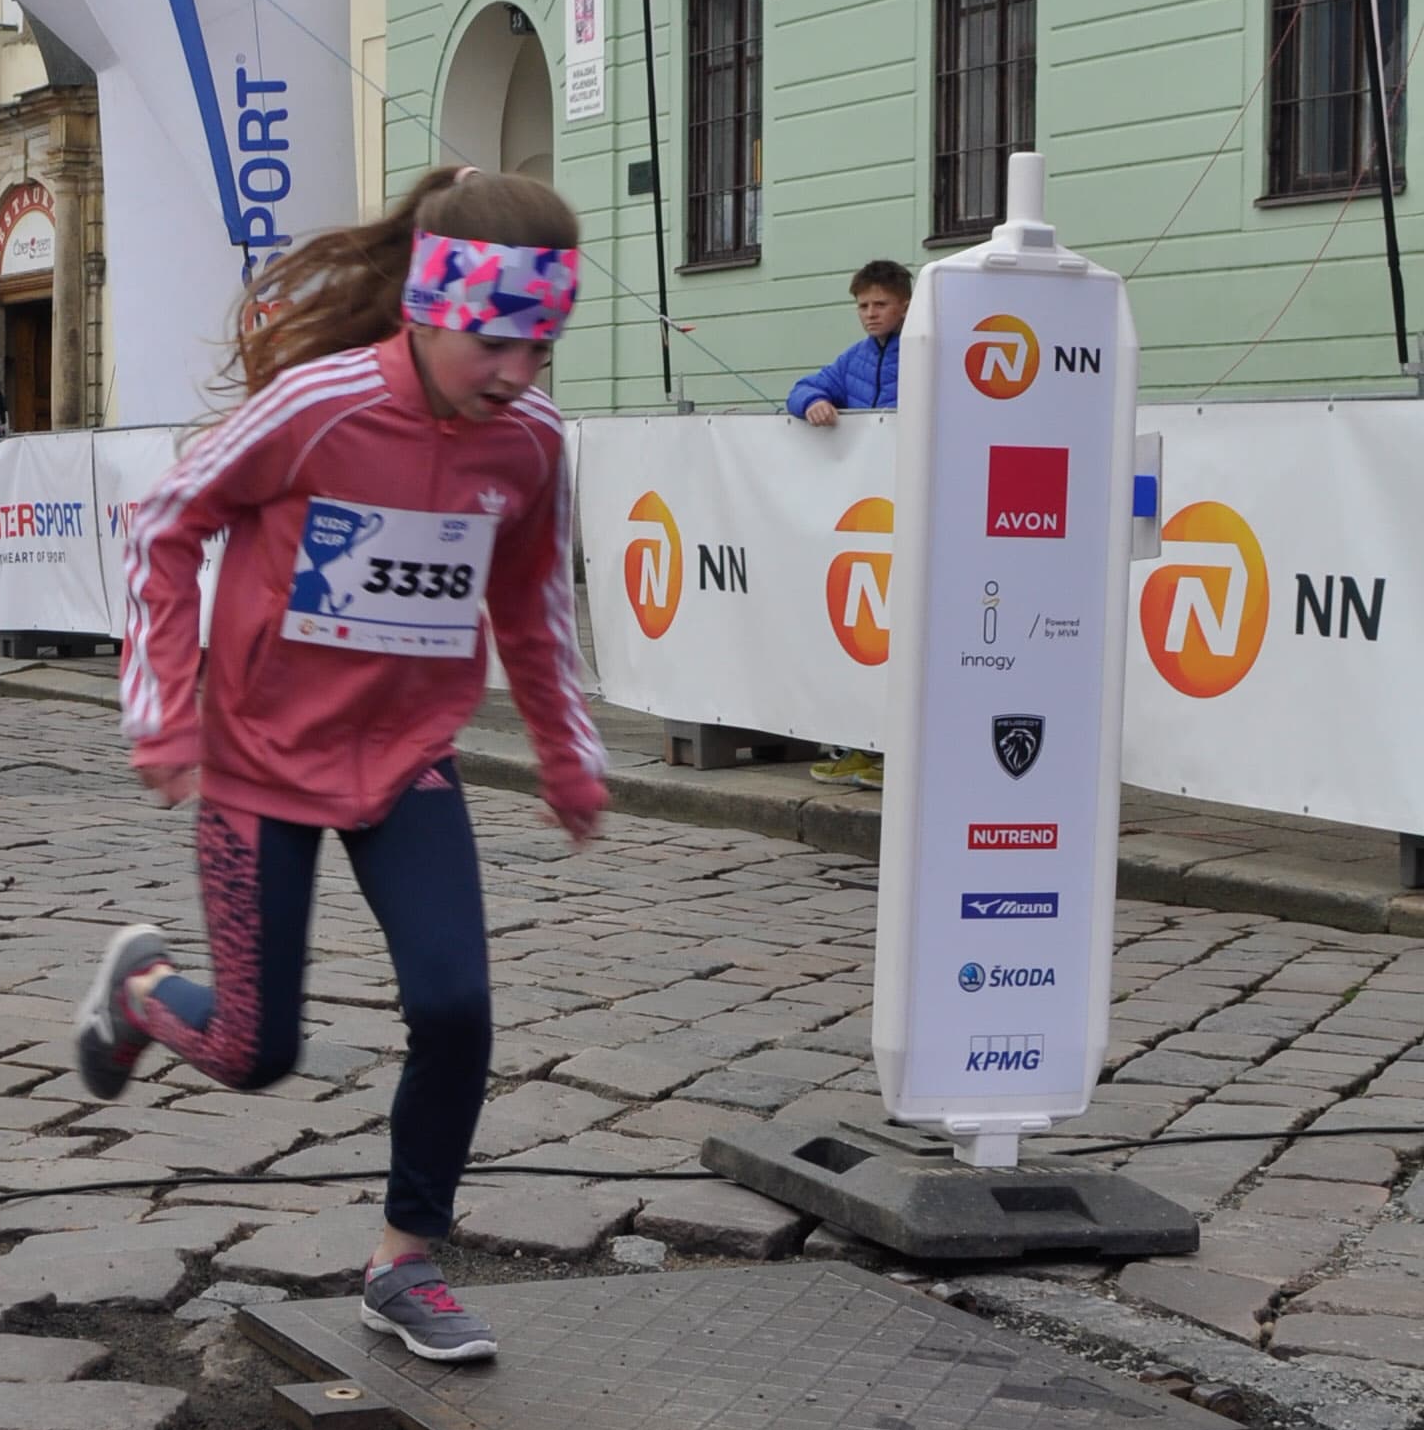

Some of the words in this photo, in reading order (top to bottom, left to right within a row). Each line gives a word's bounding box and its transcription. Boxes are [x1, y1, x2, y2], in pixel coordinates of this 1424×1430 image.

[1054, 346, 1101, 373] NN
[995, 512, 1057, 530] AVON
[362, 557, 474, 599] 3338
[697, 544, 748, 594] NN
[1295, 573, 1387, 642] NN
[1044, 629, 1056, 639] by
[1057, 628, 1079, 637] MVM
[1045, 617, 1080, 627] Powered
[960, 651, 1016, 671] innogy
[973, 829, 1054, 844] NUTREND
[989, 965, 1056, 988] ŠKODA
[965, 1049, 1041, 1072] KPMG
